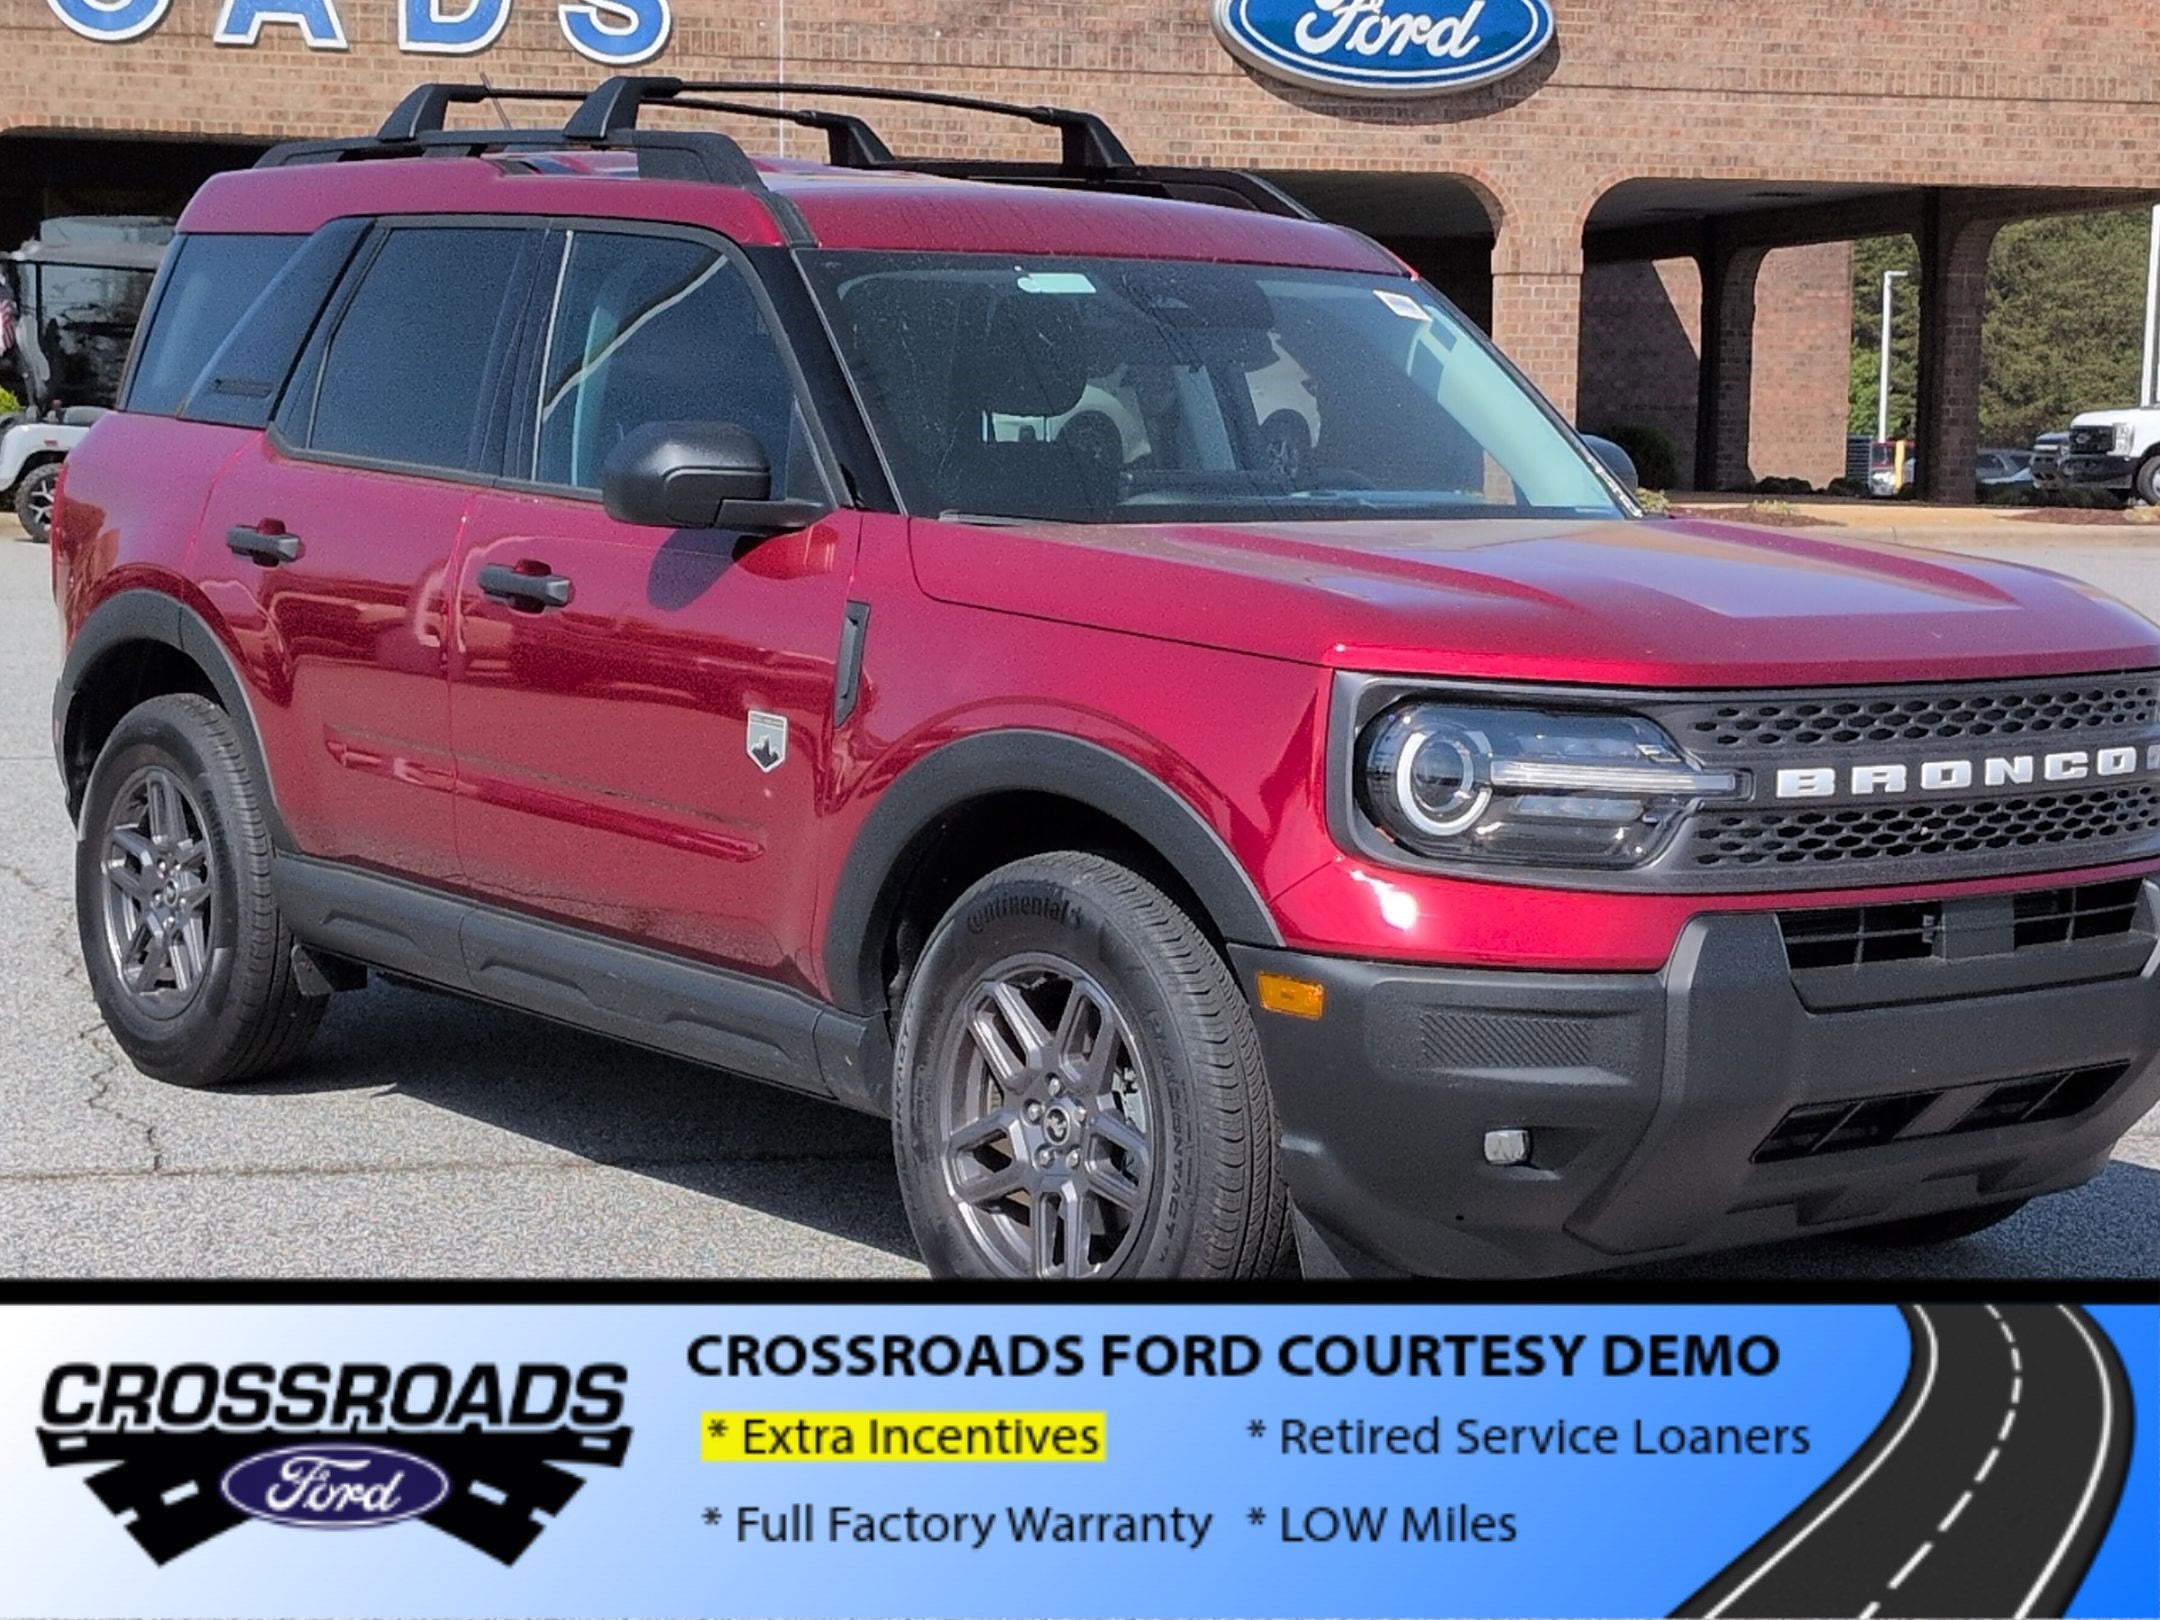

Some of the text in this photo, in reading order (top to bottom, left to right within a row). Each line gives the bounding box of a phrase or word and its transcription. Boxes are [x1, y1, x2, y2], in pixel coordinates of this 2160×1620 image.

[1294, 0, 1486, 58] Ford
[1776, 746, 2137, 799] BRONCO
[966, 893, 1070, 934] Continental
